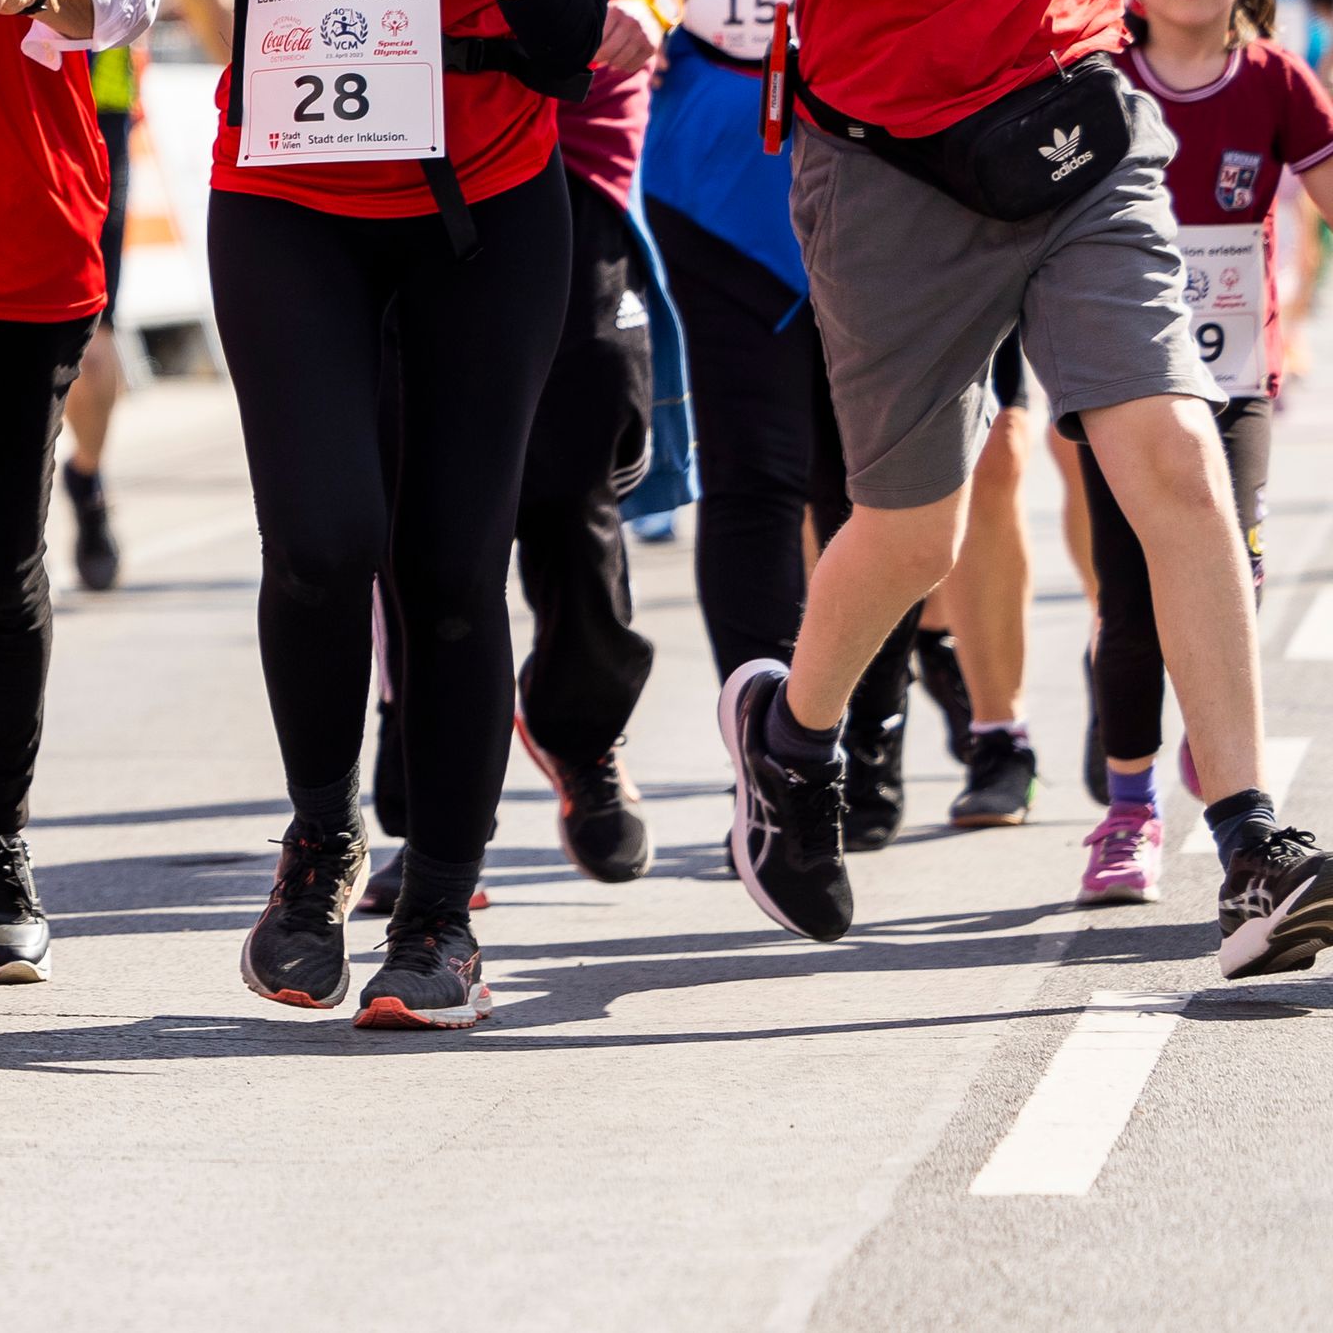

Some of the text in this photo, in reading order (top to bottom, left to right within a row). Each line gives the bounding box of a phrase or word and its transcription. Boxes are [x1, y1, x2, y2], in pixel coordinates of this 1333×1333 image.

[261, 27, 316, 54] Coca-Cola
[334, 41, 358, 50] VCM
[378, 40, 413, 48] Special
[374, 49, 418, 57] Olympics
[293, 73, 369, 122] 28
[282, 132, 407, 145] Stadt Stadt der Inklusion.
[282, 141, 300, 149] Wien
[1051, 151, 1094, 181] adidas
